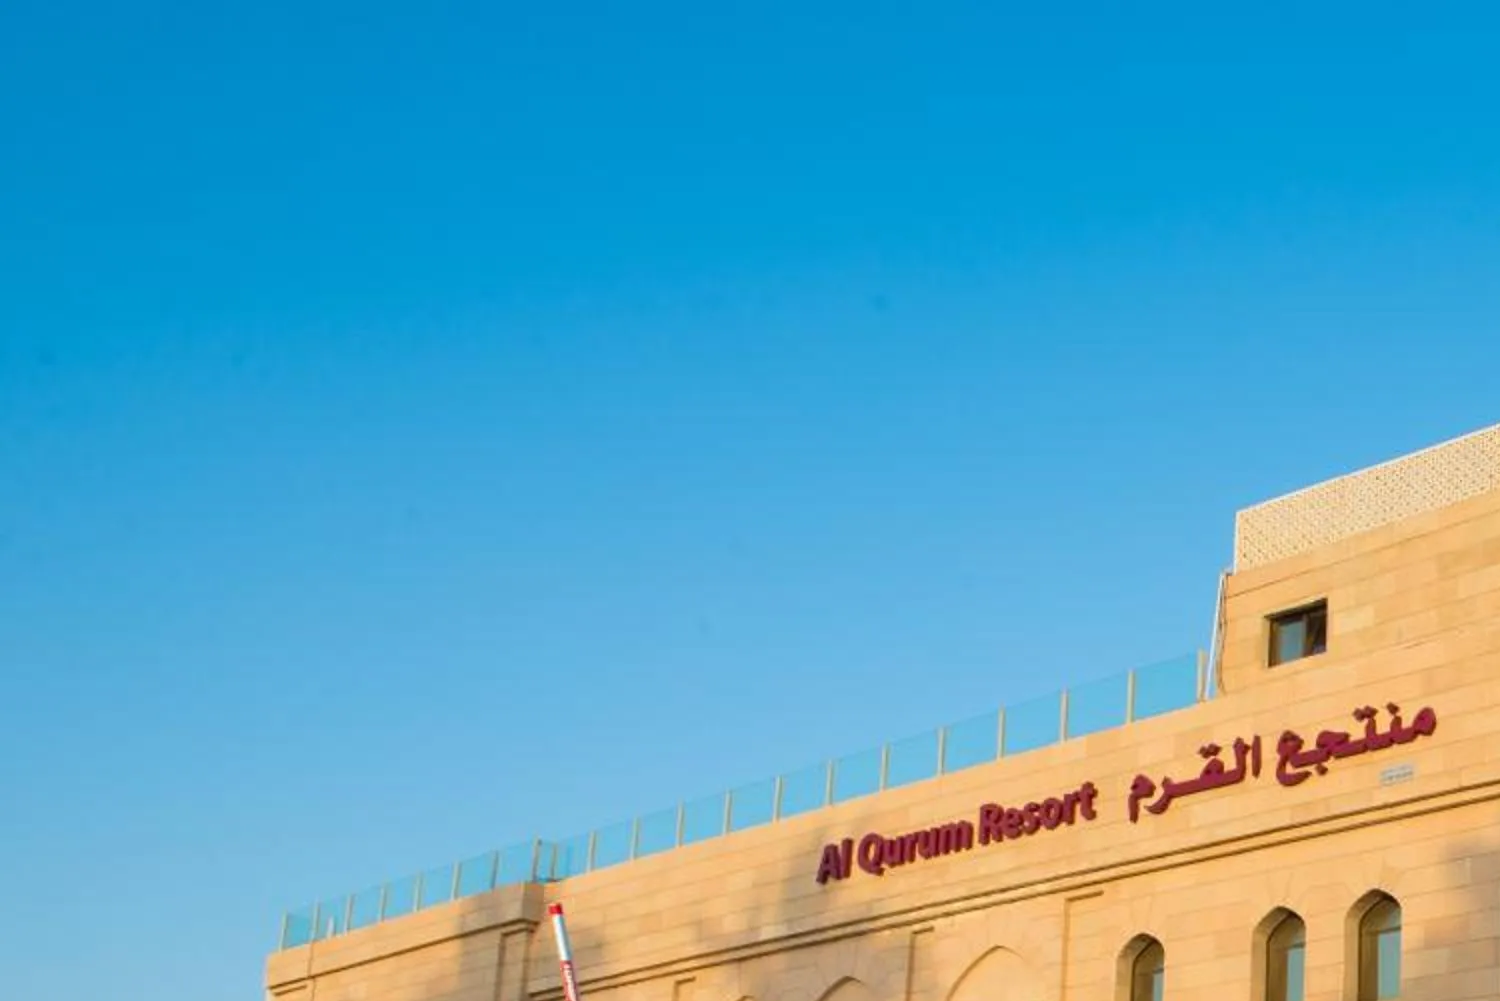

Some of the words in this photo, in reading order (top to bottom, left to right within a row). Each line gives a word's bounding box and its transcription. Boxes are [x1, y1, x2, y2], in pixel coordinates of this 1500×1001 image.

[1127, 733, 1263, 824] القرم
[1276, 701, 1438, 787] منتجع
[816, 837, 854, 885] Al
[857, 820, 974, 876] Qurum
[978, 781, 1099, 846] Resort
